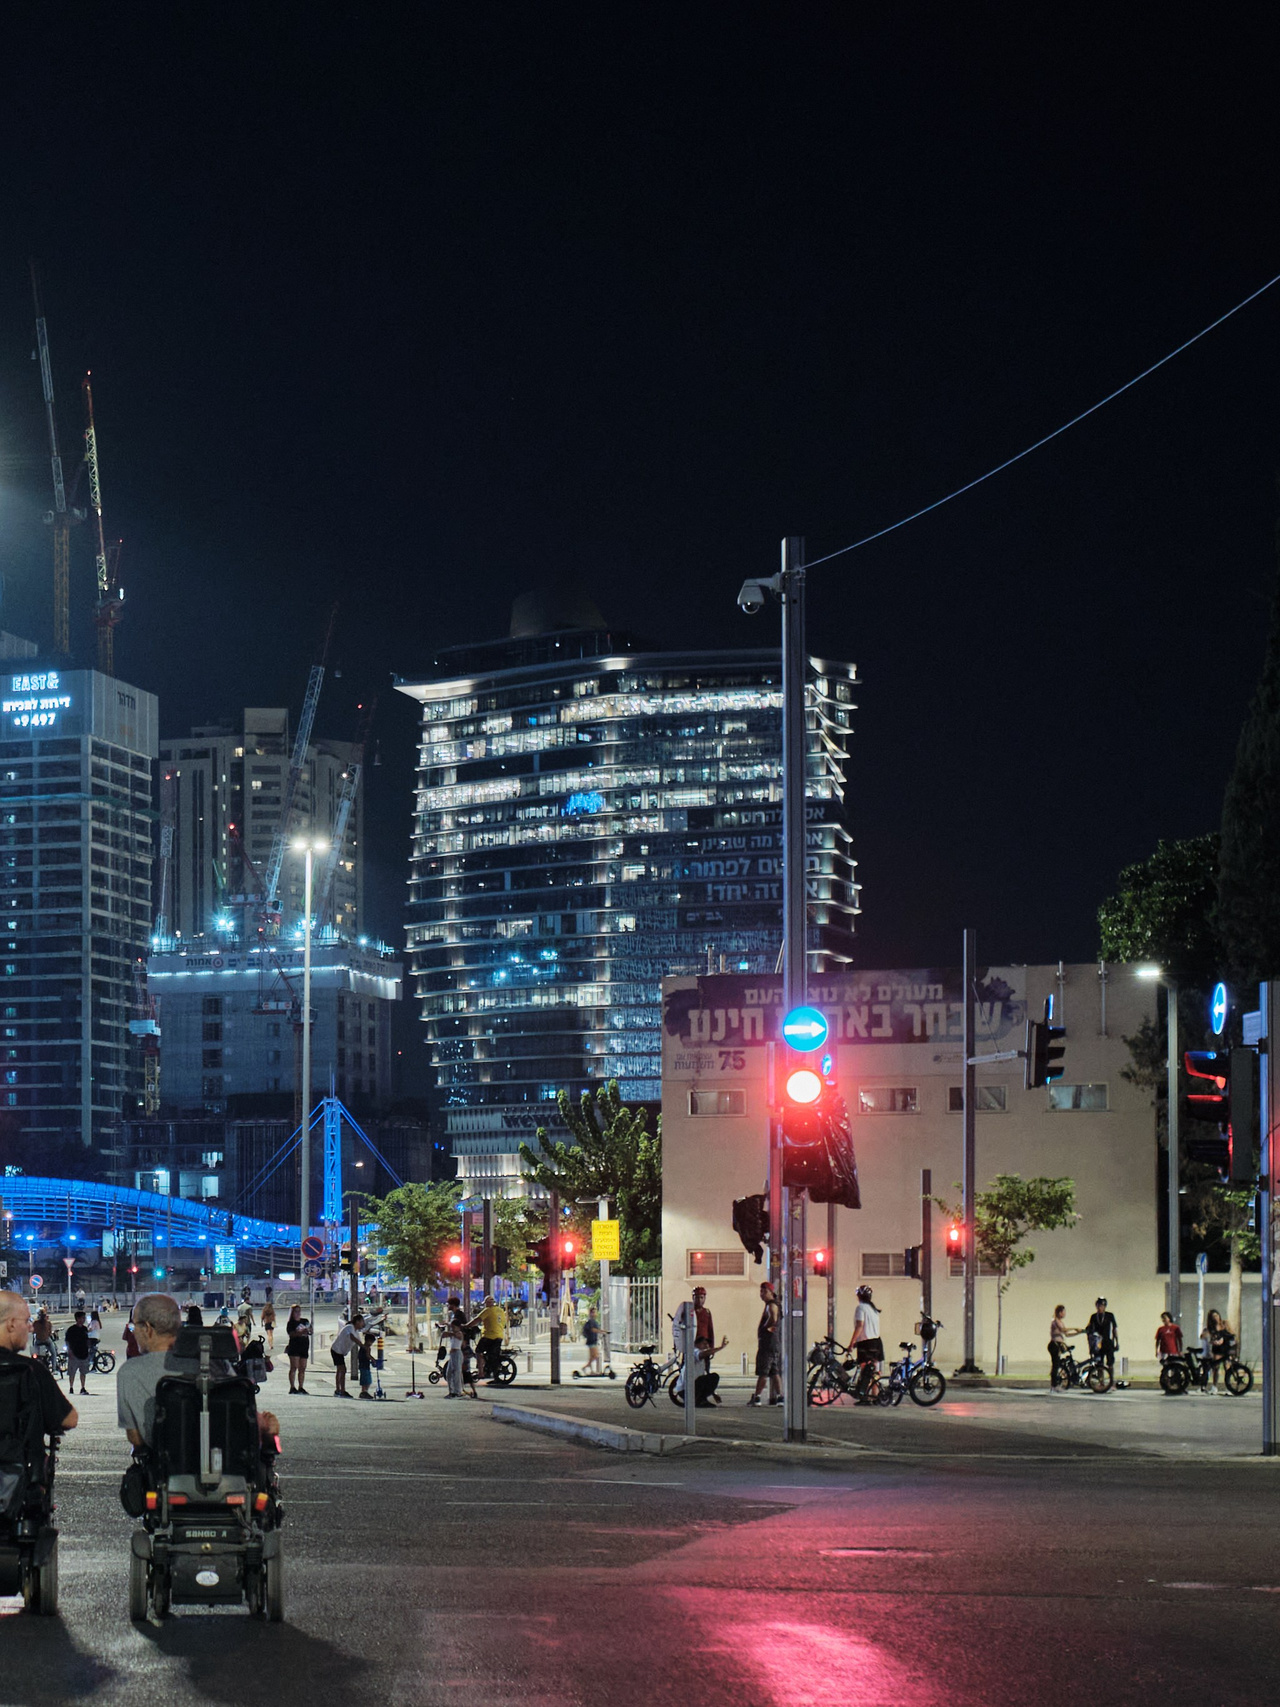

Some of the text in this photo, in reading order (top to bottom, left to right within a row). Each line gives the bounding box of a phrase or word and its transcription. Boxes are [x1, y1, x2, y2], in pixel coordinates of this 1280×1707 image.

[39, 696, 71, 710] דירות
[702, 836, 746, 851] שבנינו
[750, 834, 772, 849] מה
[691, 857, 751, 878] לפתור
[707, 884, 747, 902] יחד!
[754, 883, 778, 900] זה
[186, 957, 211, 967] אמות
[744, 983, 944, 1005] מעולם לא נוצ העם
[903, 1002, 1003, 1038] שבחר
[718, 1050, 746, 1071] 75
